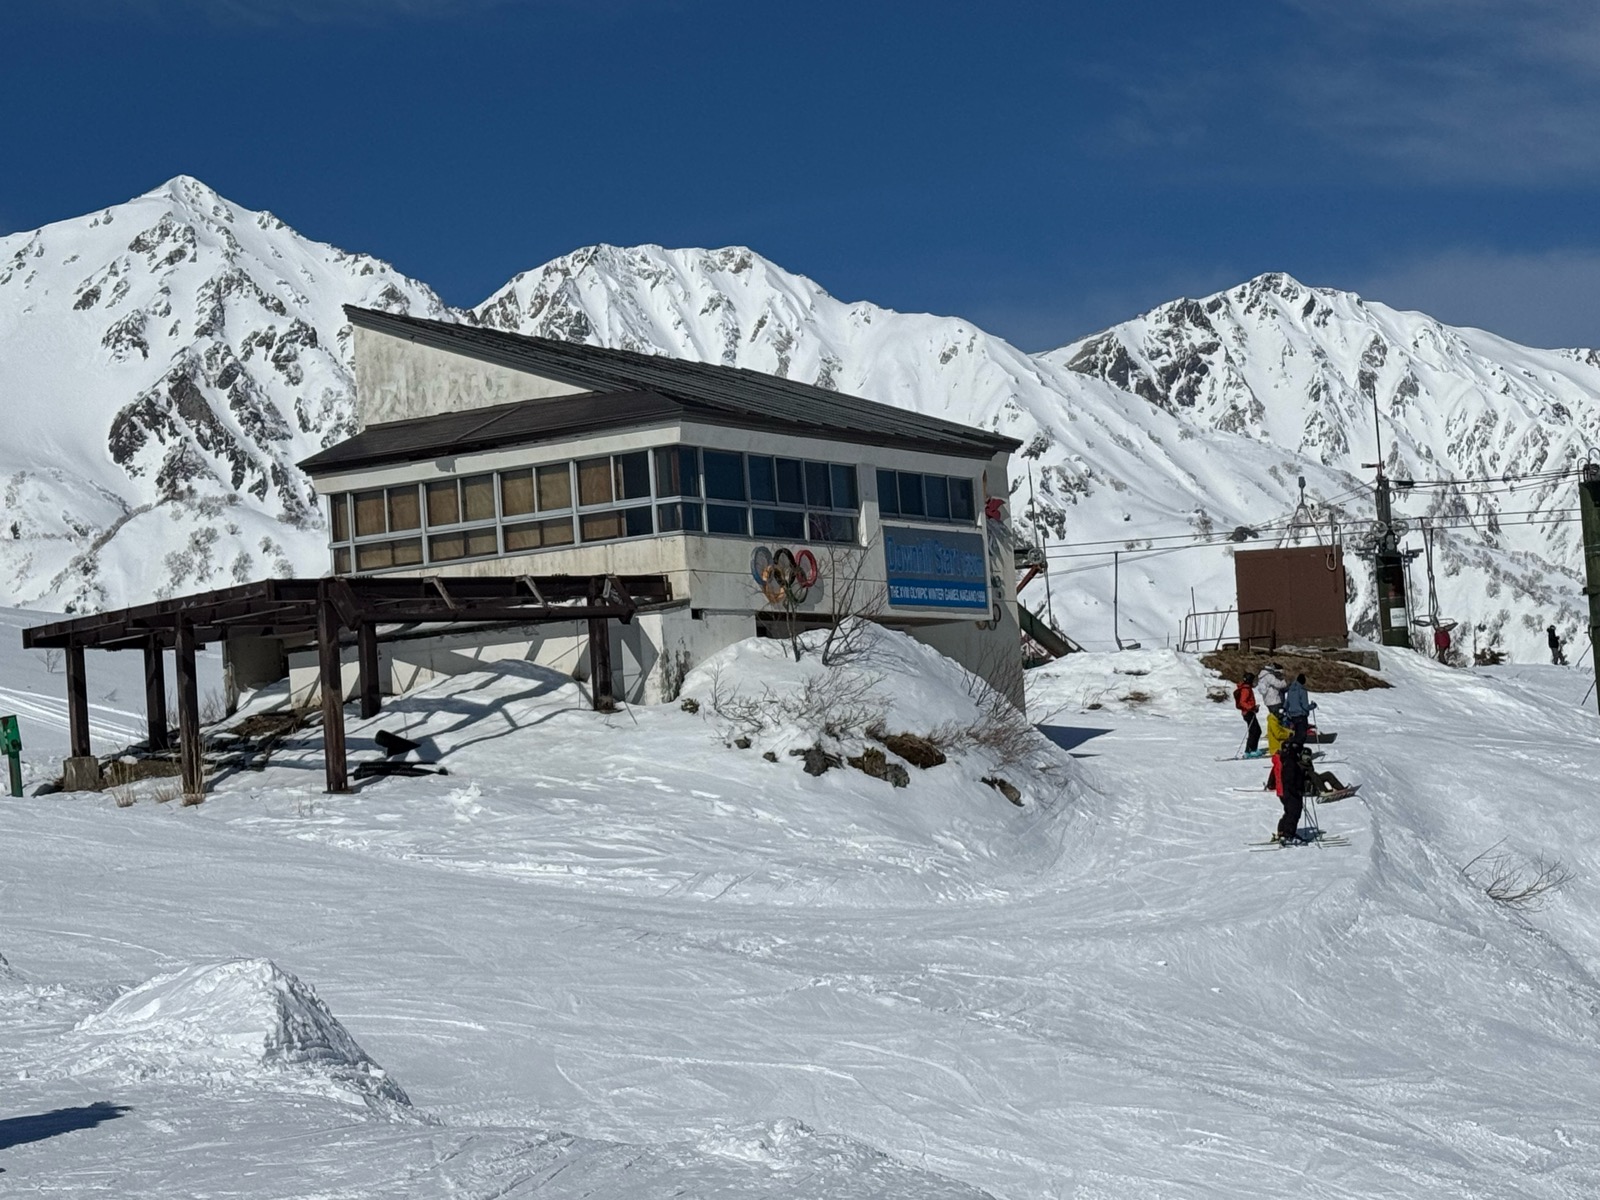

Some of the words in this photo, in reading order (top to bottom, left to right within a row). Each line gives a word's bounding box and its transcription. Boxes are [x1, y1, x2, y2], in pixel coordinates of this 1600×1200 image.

[886, 536, 934, 573] Downhill
[889, 585, 900, 599] THE
[910, 586, 928, 600] OLYMPIC
[928, 587, 944, 601] WINTER
[960, 589, 977, 602] NAGANO
